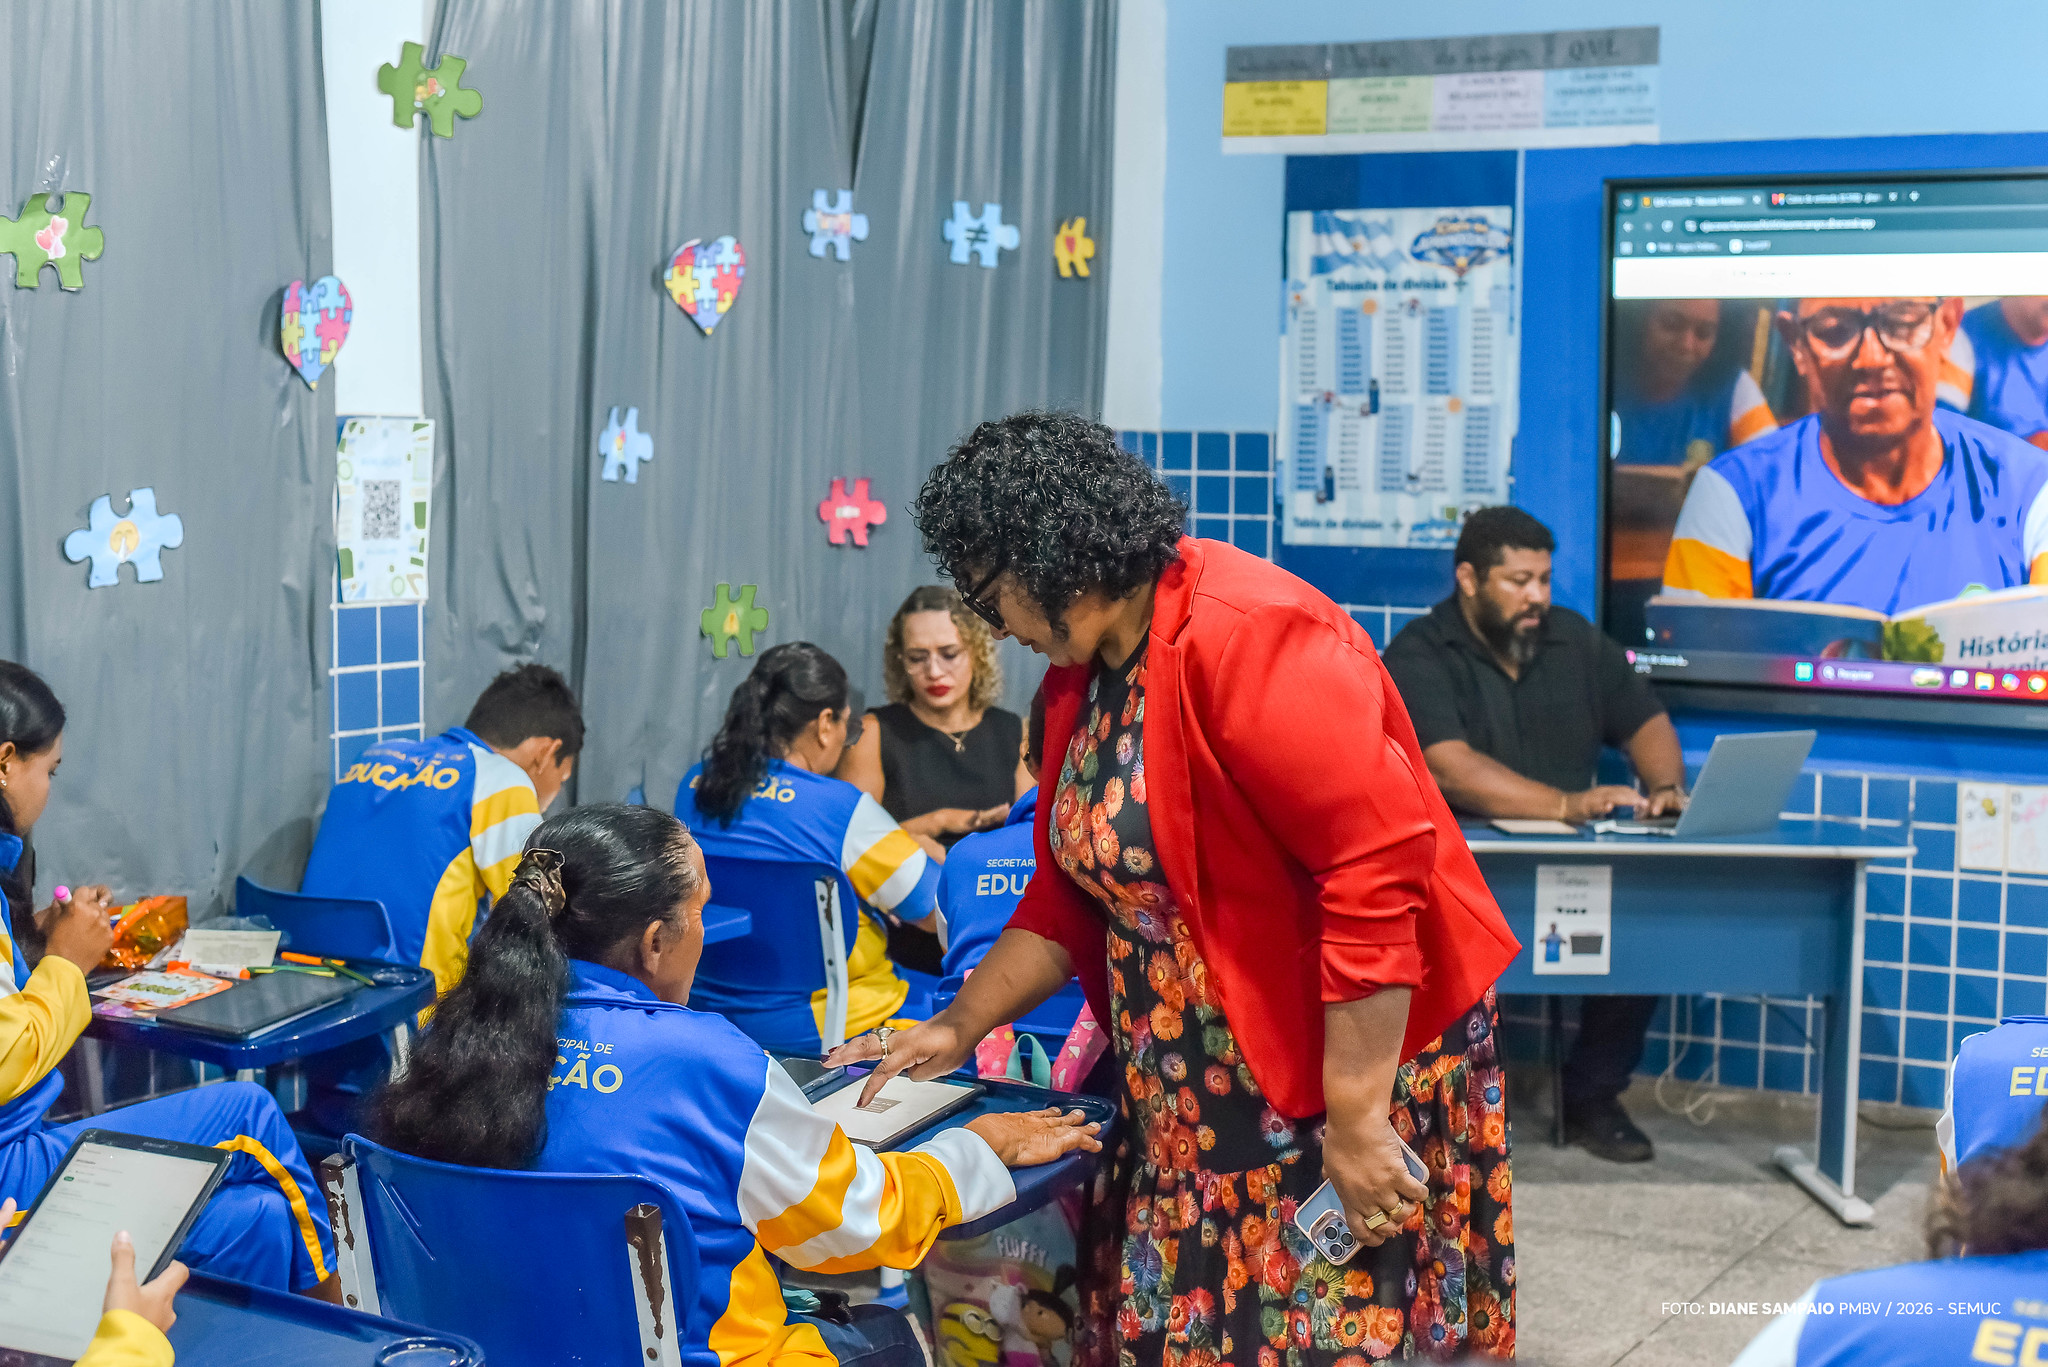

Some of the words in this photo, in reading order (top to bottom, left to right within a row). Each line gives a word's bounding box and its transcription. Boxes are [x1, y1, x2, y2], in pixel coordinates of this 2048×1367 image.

[976, 874, 1029, 896] EDU
[593, 1042, 615, 1055] DE
[996, 1235, 1048, 1267] FLUFFY
